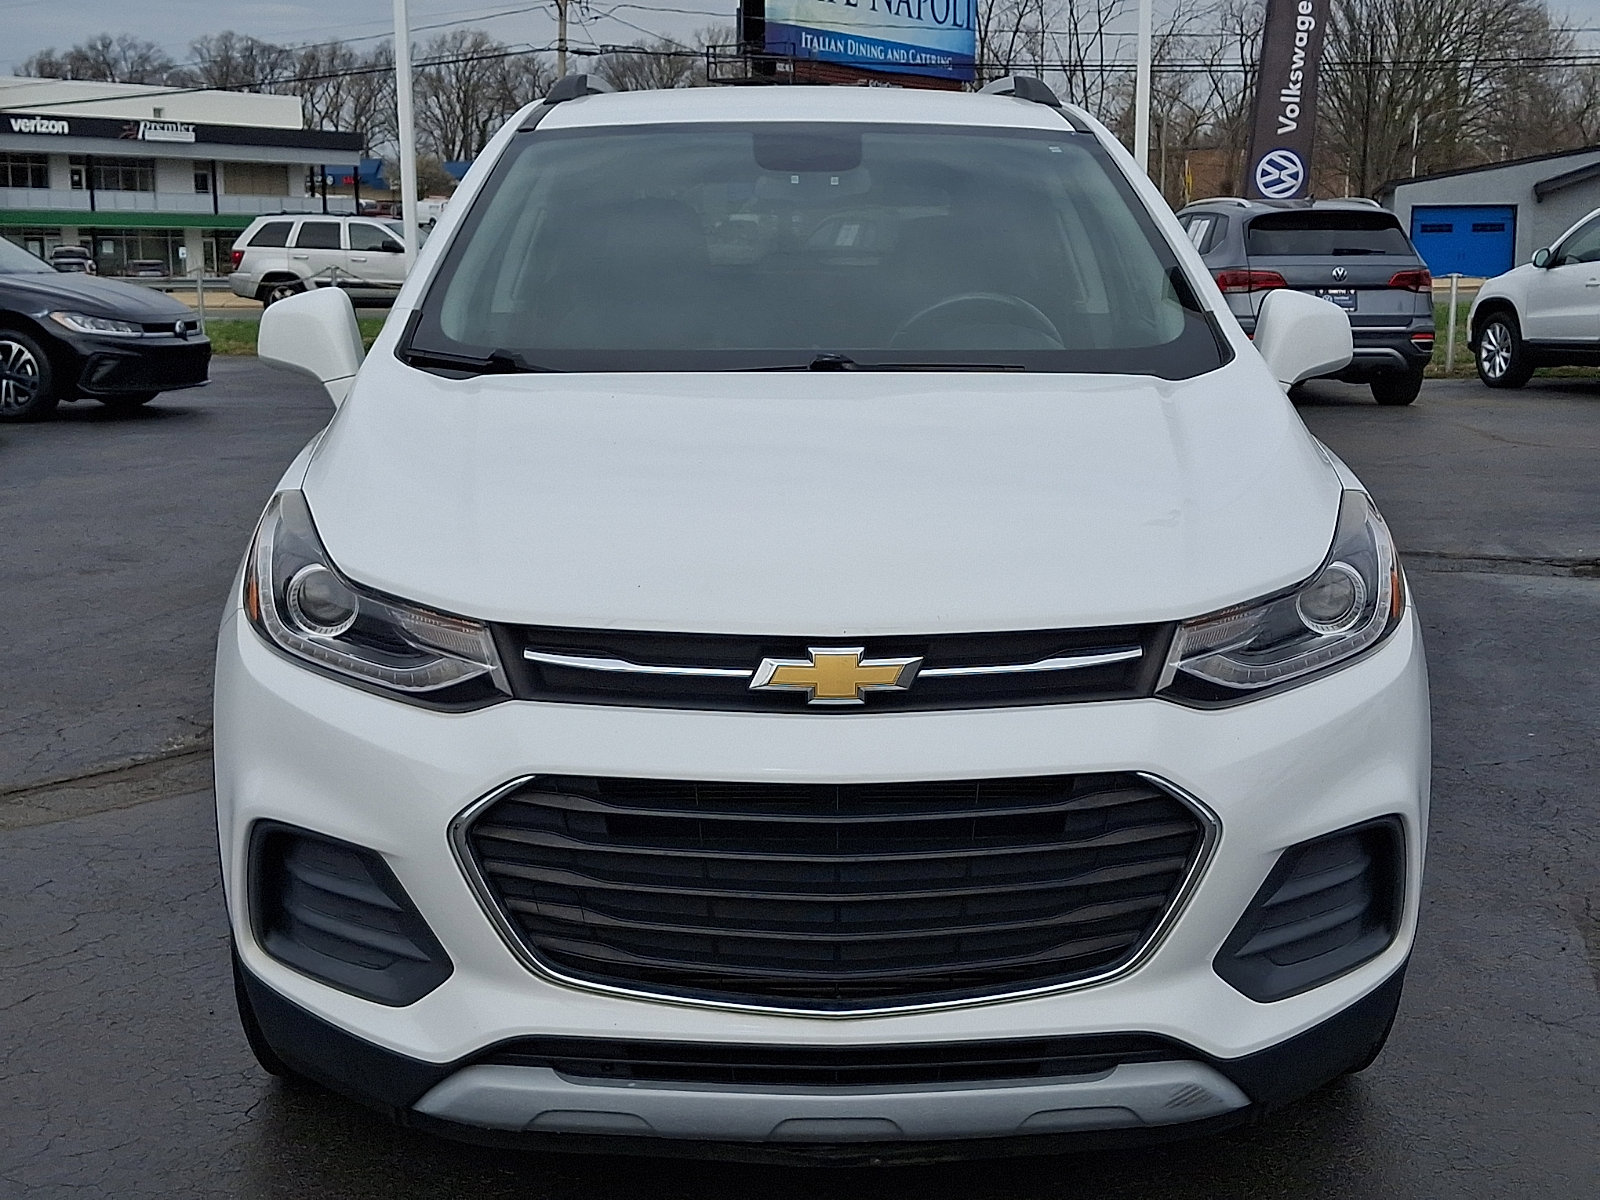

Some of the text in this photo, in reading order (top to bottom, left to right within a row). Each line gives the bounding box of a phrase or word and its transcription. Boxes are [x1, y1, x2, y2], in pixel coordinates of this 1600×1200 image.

[801, 32, 953, 71] ITALIAN DINING AND CATERING
[10, 116, 69, 134] verizon
